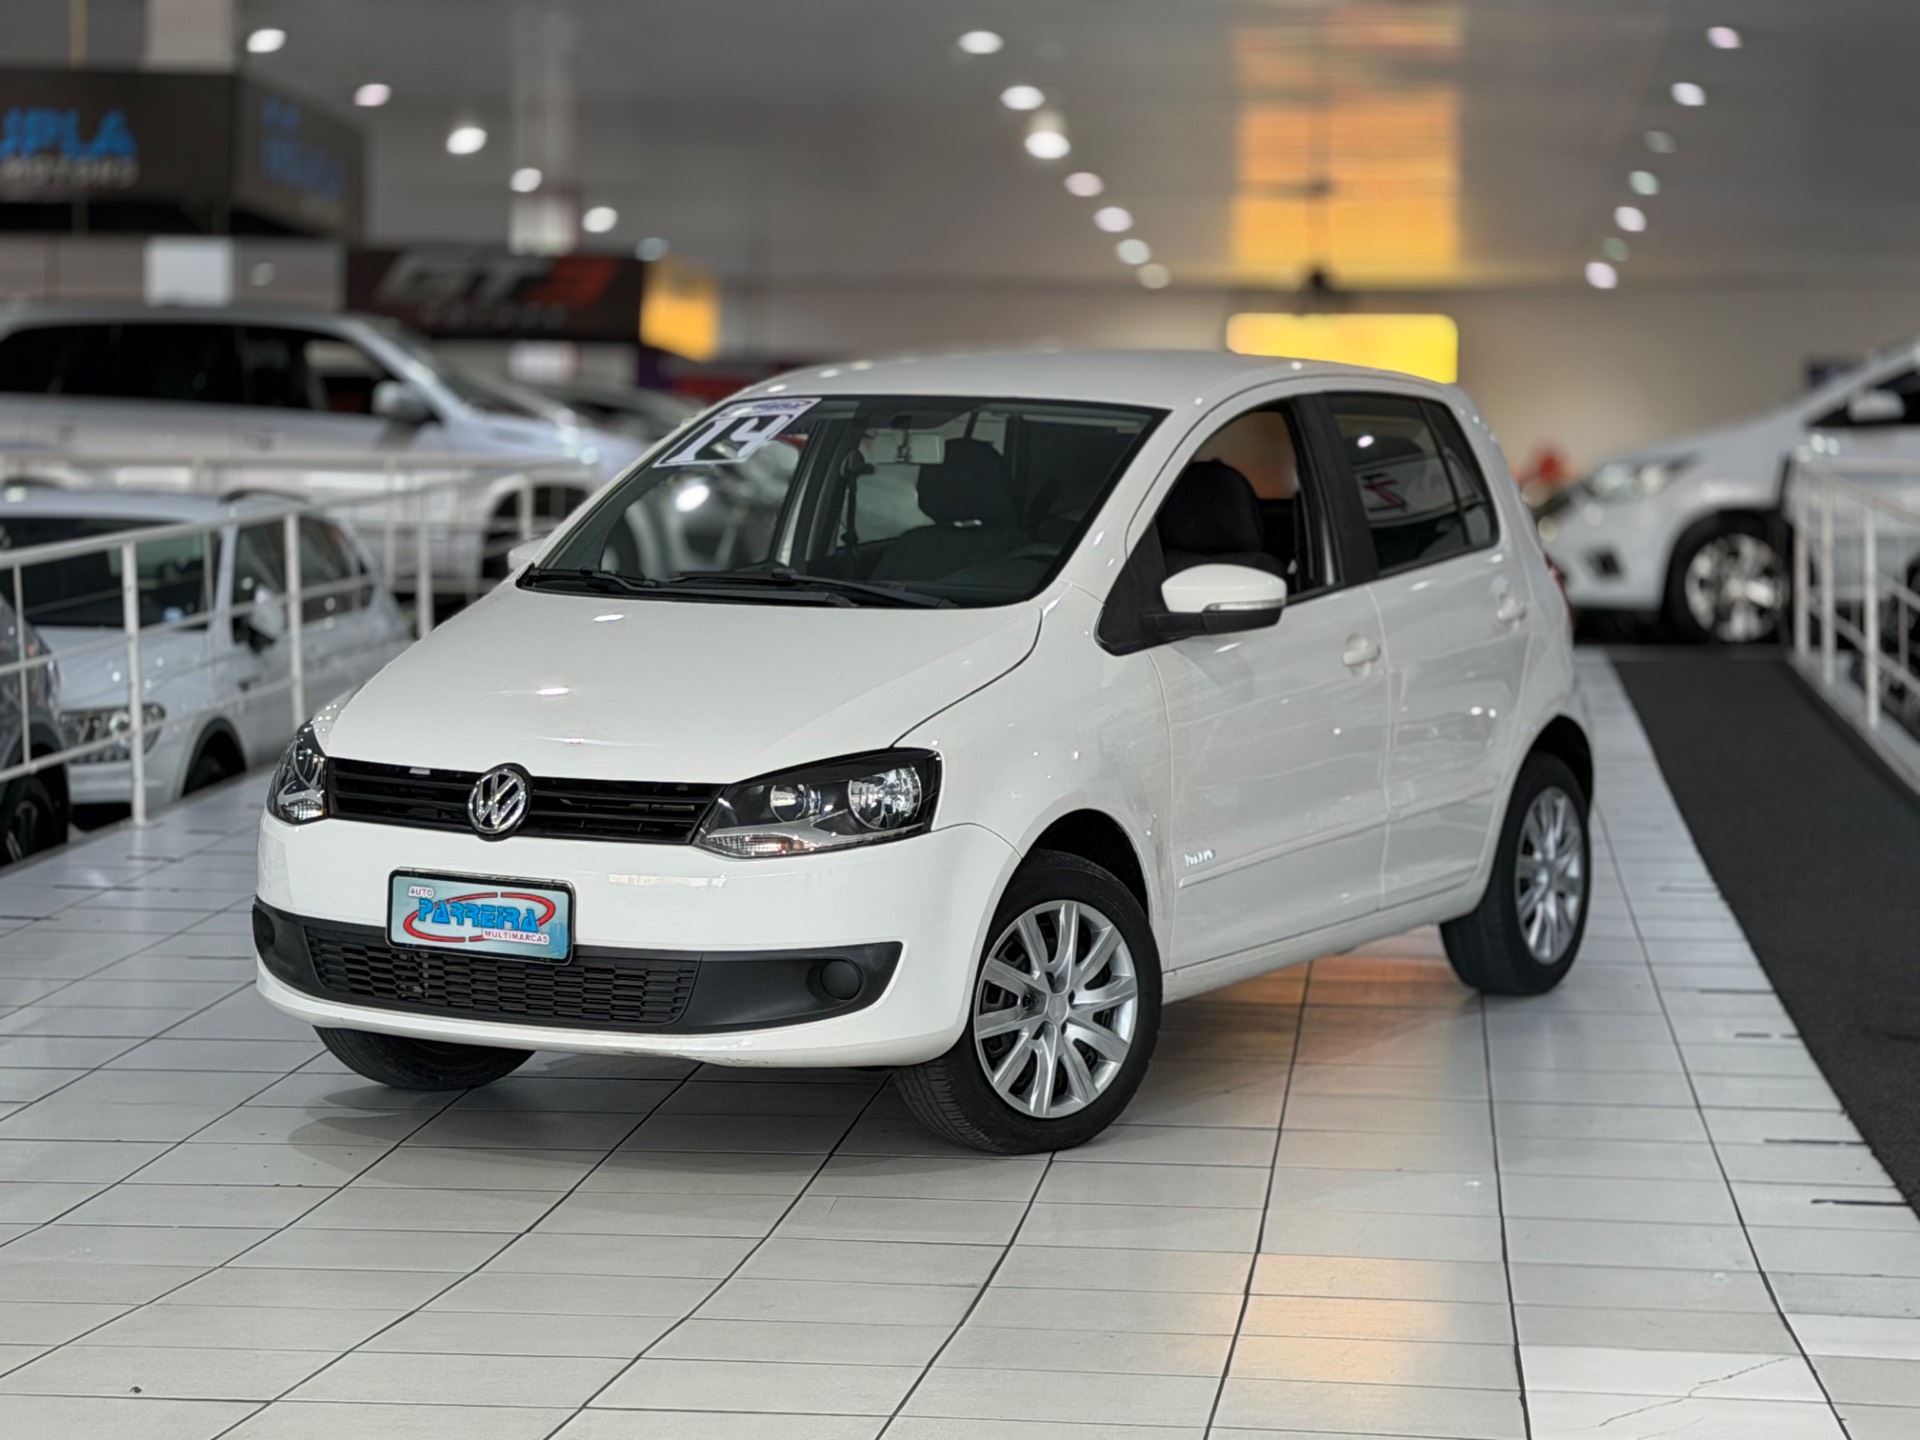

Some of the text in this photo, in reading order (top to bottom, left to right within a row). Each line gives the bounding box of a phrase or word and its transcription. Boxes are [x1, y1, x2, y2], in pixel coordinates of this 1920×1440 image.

[409, 886, 433, 897] AUTO
[418, 898, 539, 932] PARREIRA
[484, 930, 549, 943] MULTIMARCAS
